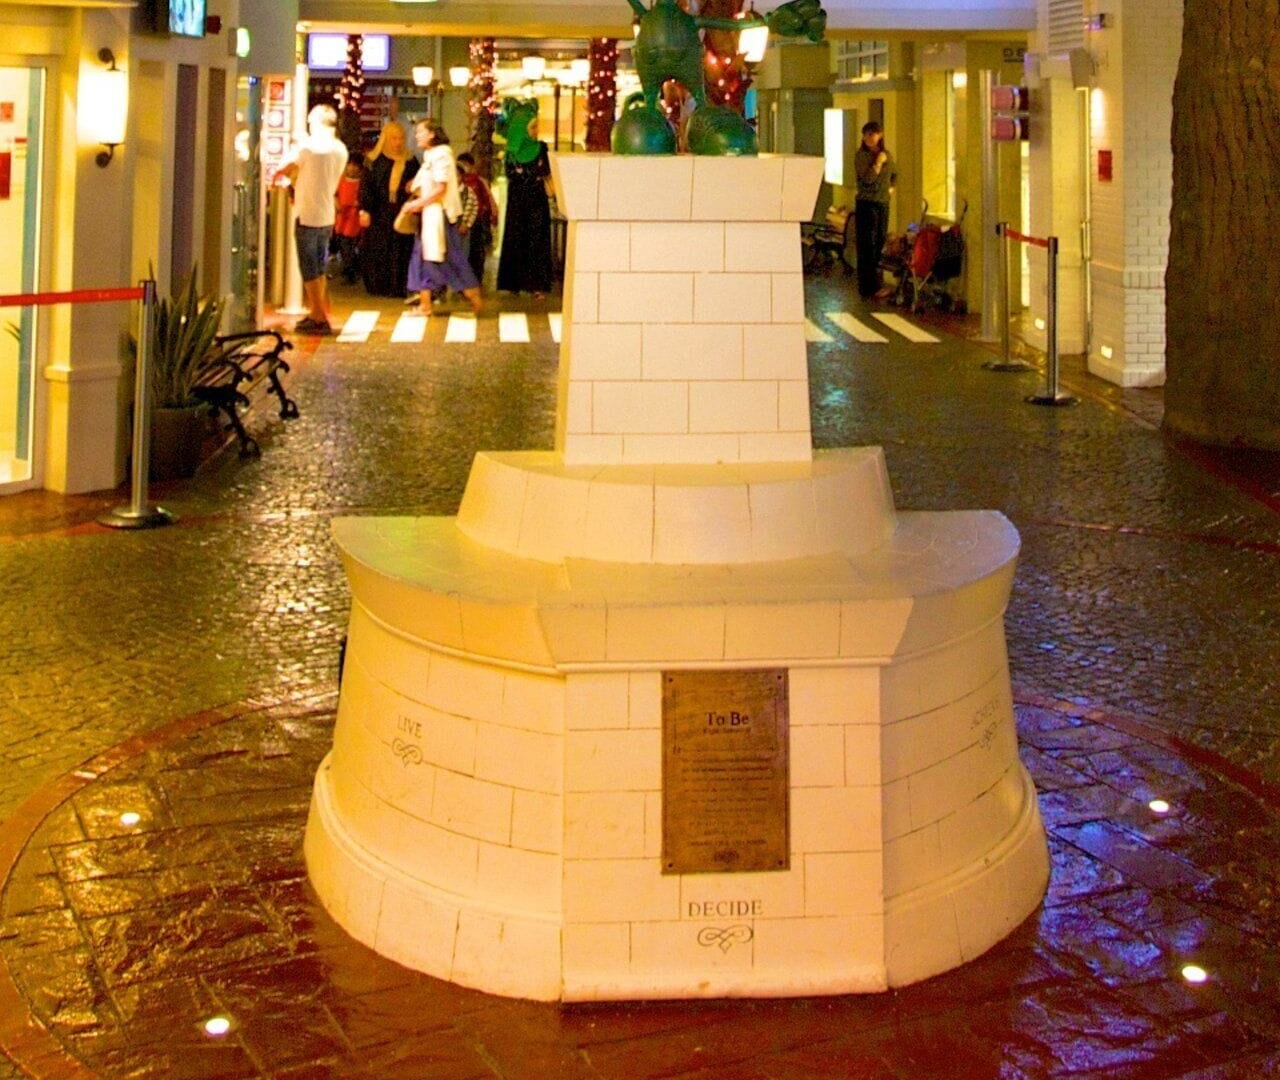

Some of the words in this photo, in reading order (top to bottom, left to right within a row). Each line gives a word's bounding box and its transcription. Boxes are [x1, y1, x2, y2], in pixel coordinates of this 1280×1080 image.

[397, 715, 422, 739] LIVE
[704, 711, 725, 726] To
[731, 711, 749, 726] Be
[687, 900, 764, 917] DECIDE
